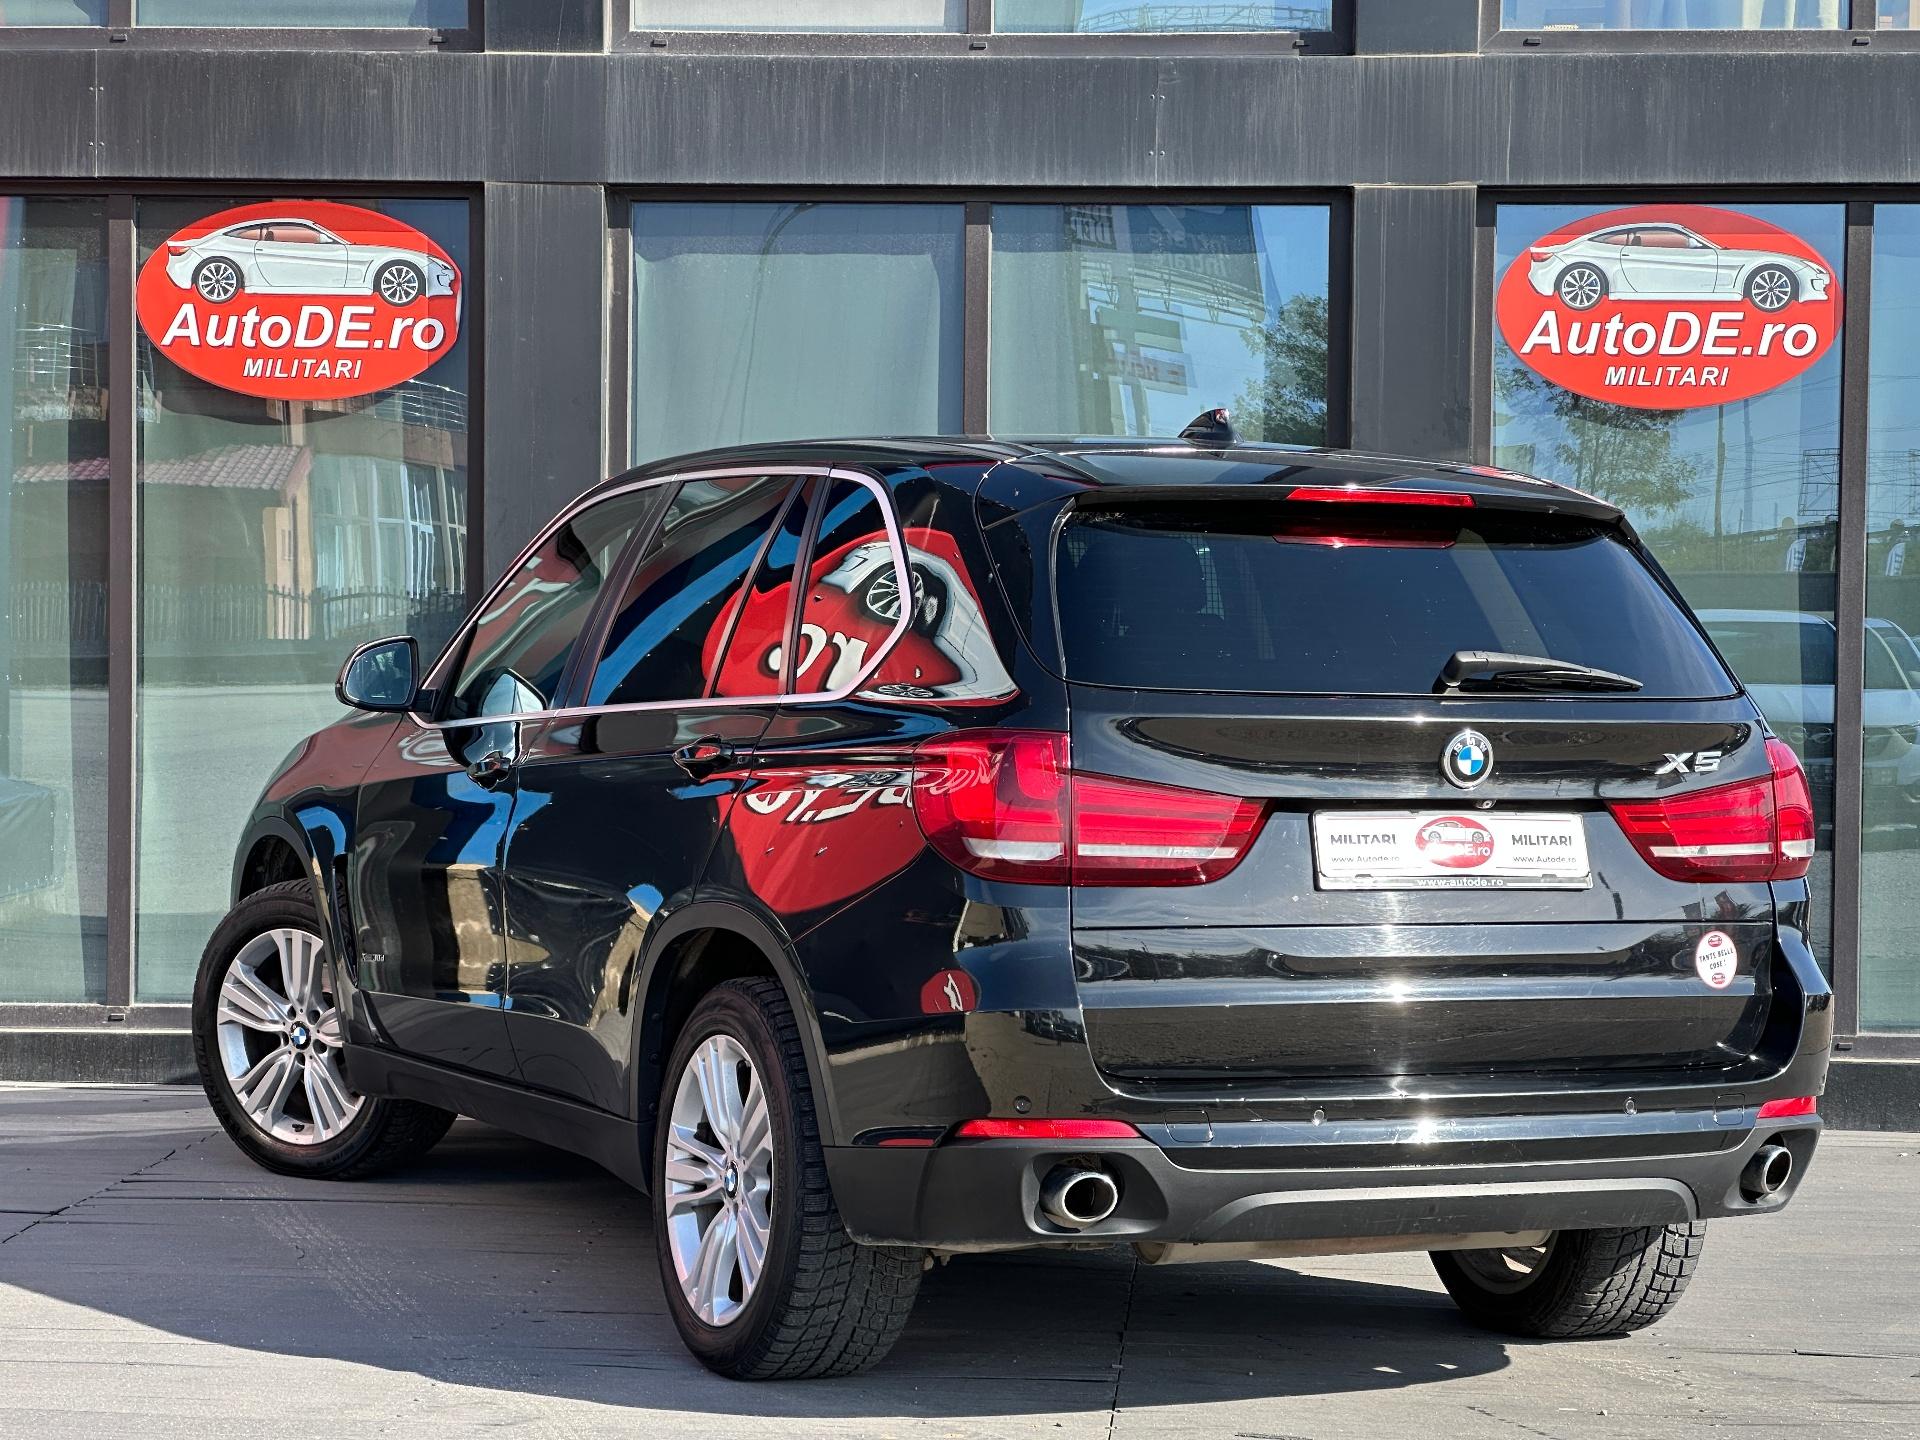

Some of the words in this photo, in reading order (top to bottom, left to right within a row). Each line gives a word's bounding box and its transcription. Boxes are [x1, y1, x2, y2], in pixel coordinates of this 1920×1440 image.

[161, 303, 445, 350] AutoDE.ro
[1520, 310, 1817, 357] AutoDE.ro
[242, 358, 362, 379] MILITARI
[1604, 366, 1729, 387] MILITARI
[1654, 751, 1722, 775] X5
[1330, 834, 1397, 845] MILITARI
[1511, 834, 1572, 846] MILITARI
[1417, 876, 1504, 887] www.autode.ro
